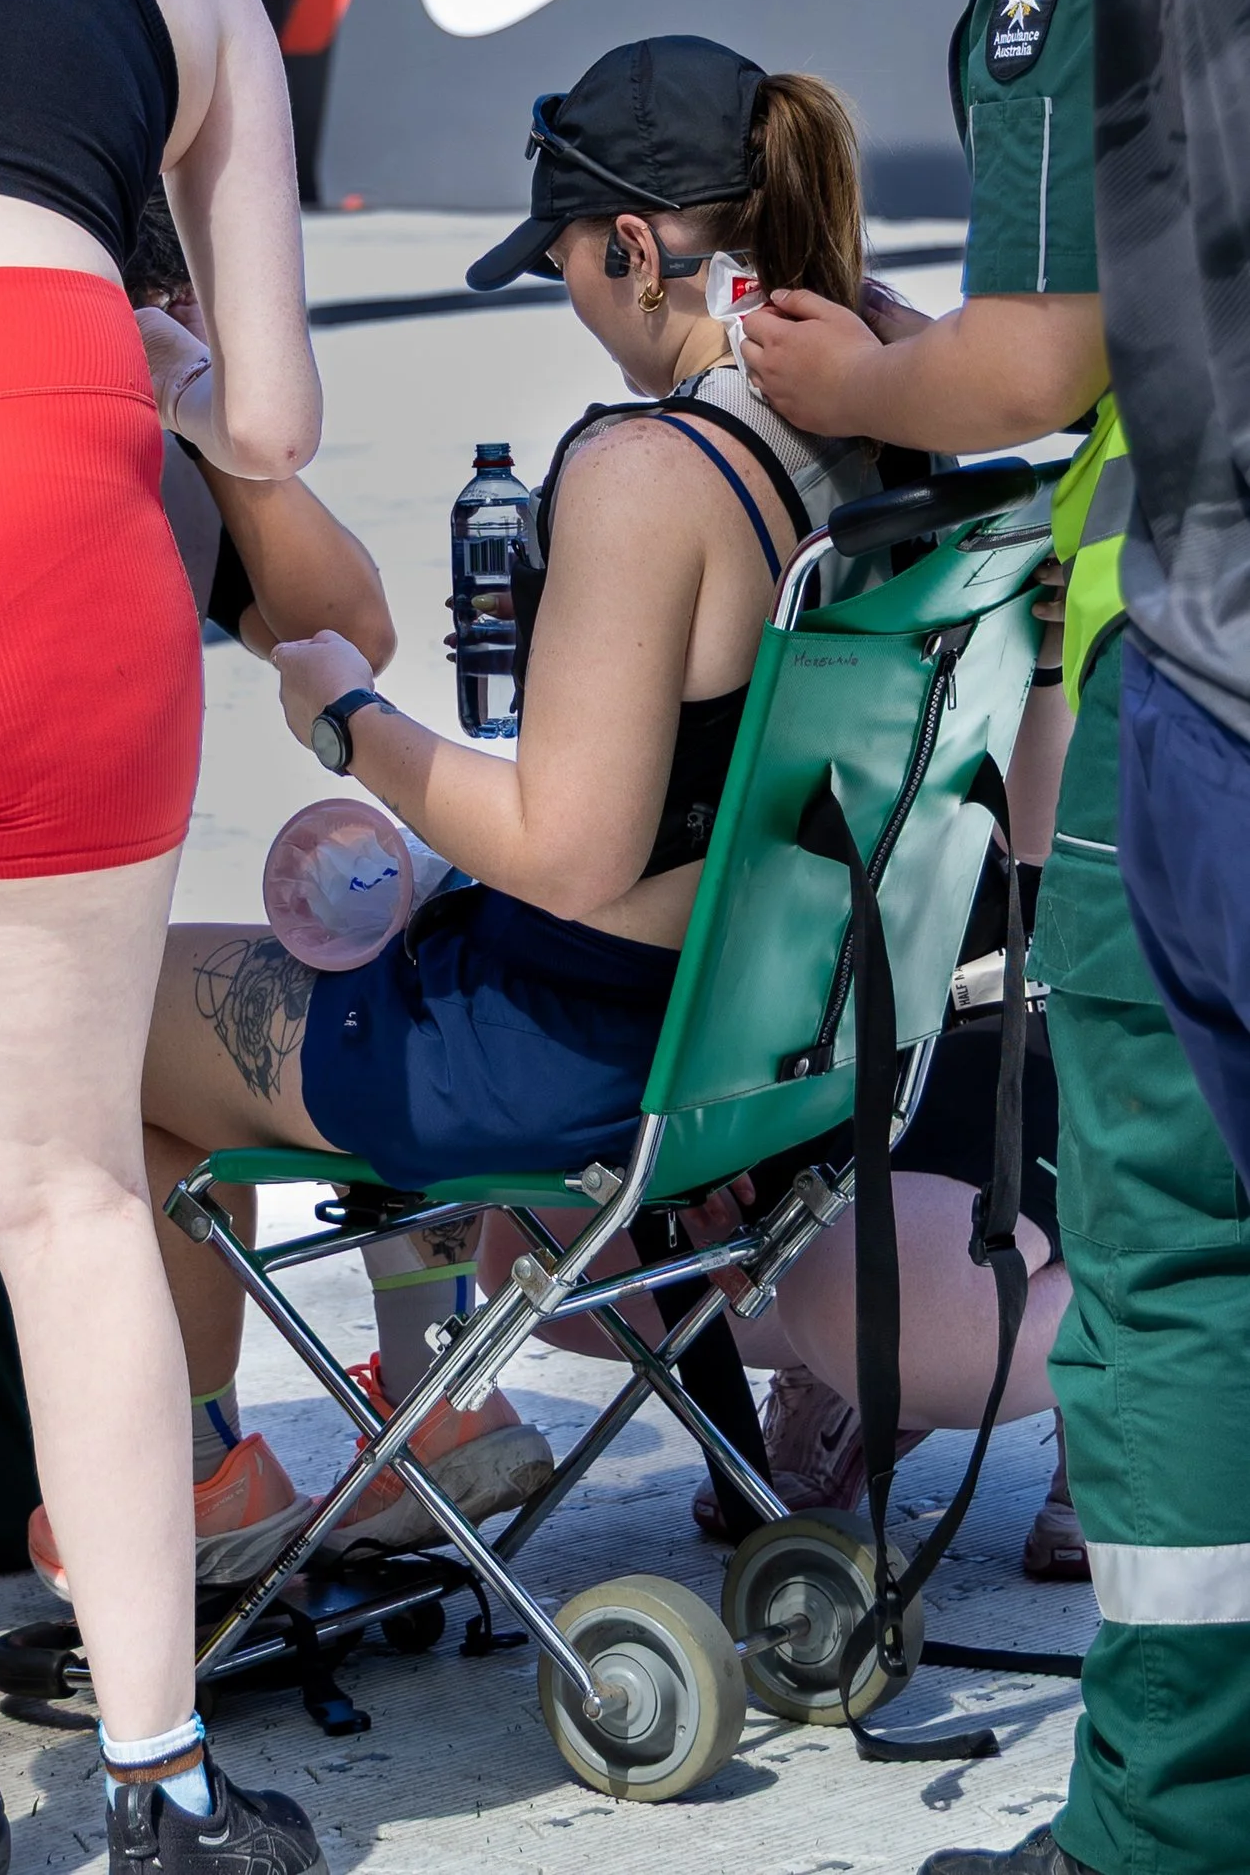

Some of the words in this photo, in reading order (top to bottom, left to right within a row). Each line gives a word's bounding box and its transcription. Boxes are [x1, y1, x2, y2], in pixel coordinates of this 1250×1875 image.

[993, 29, 1040, 46] Ambulance
[994, 42, 1033, 59] Australia
[955, 984, 971, 1007] HALF
